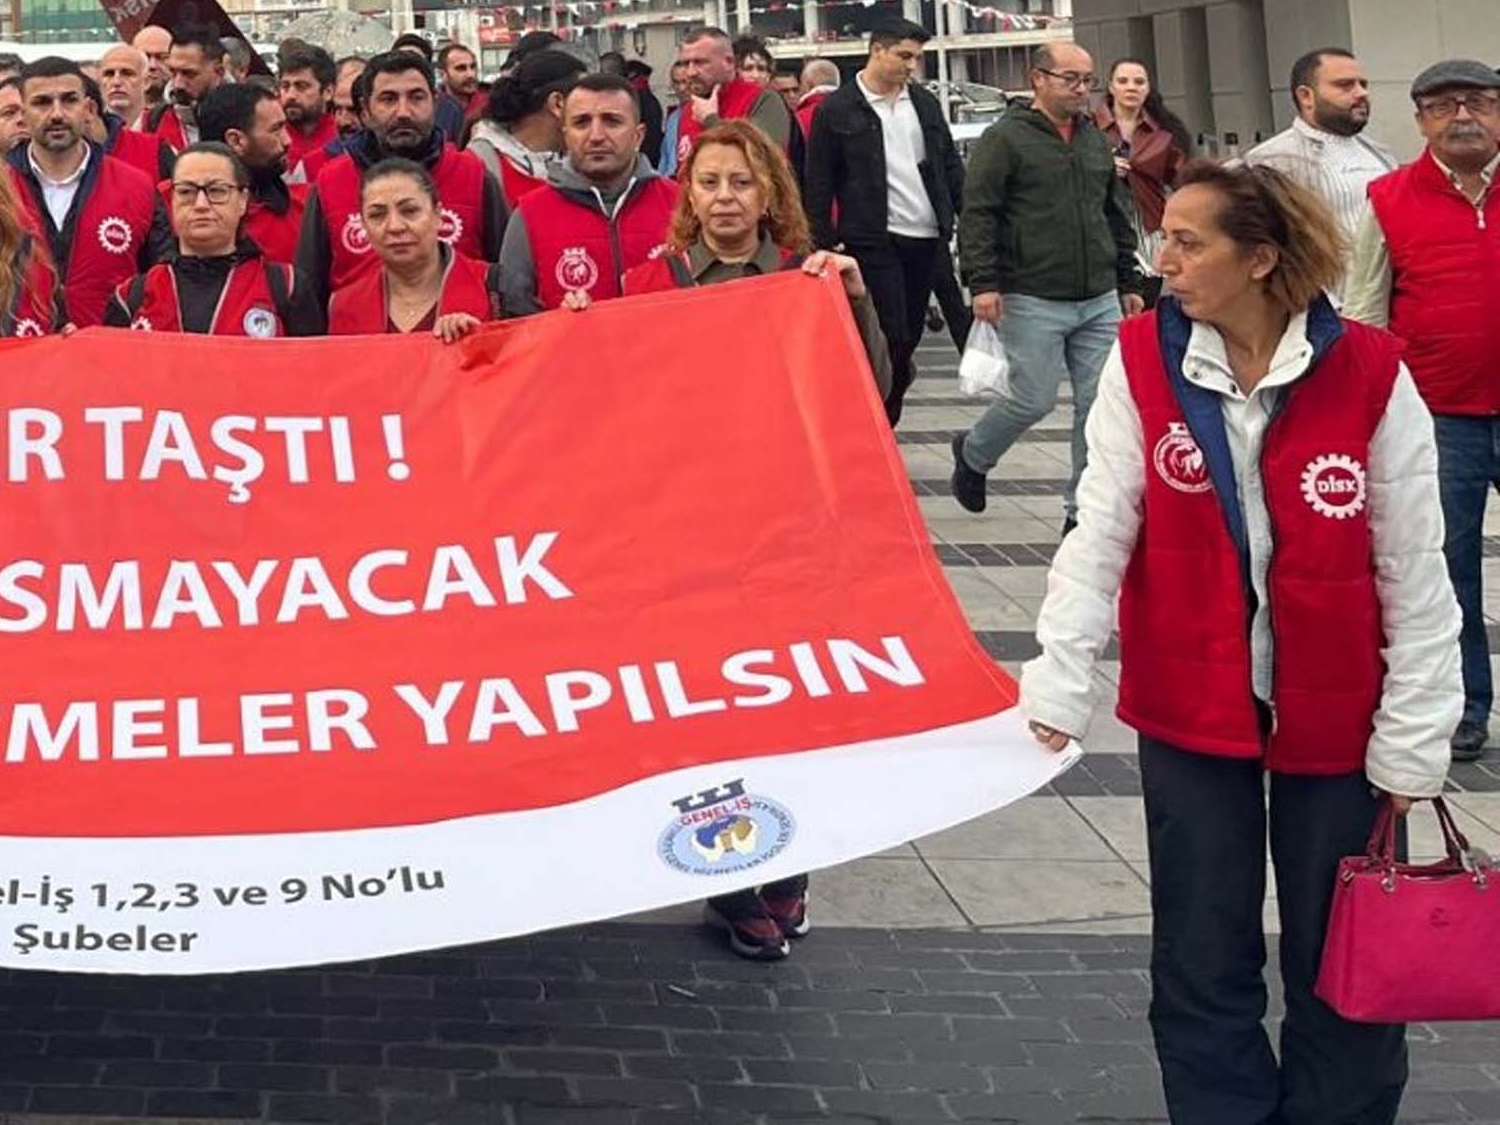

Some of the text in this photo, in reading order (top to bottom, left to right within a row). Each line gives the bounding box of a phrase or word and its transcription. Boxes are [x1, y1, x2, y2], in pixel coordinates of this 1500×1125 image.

[86, 406, 355, 504] TAŞTI
[382, 414, 410, 480] !
[394, 636, 925, 745] YAPILSIN
[90, 883, 200, 913] 1,2,3
[213, 885, 268, 907] ve
[280, 878, 308, 904] 9
[322, 866, 446, 902] No'lu
[13, 923, 199, 956] Şubeler
